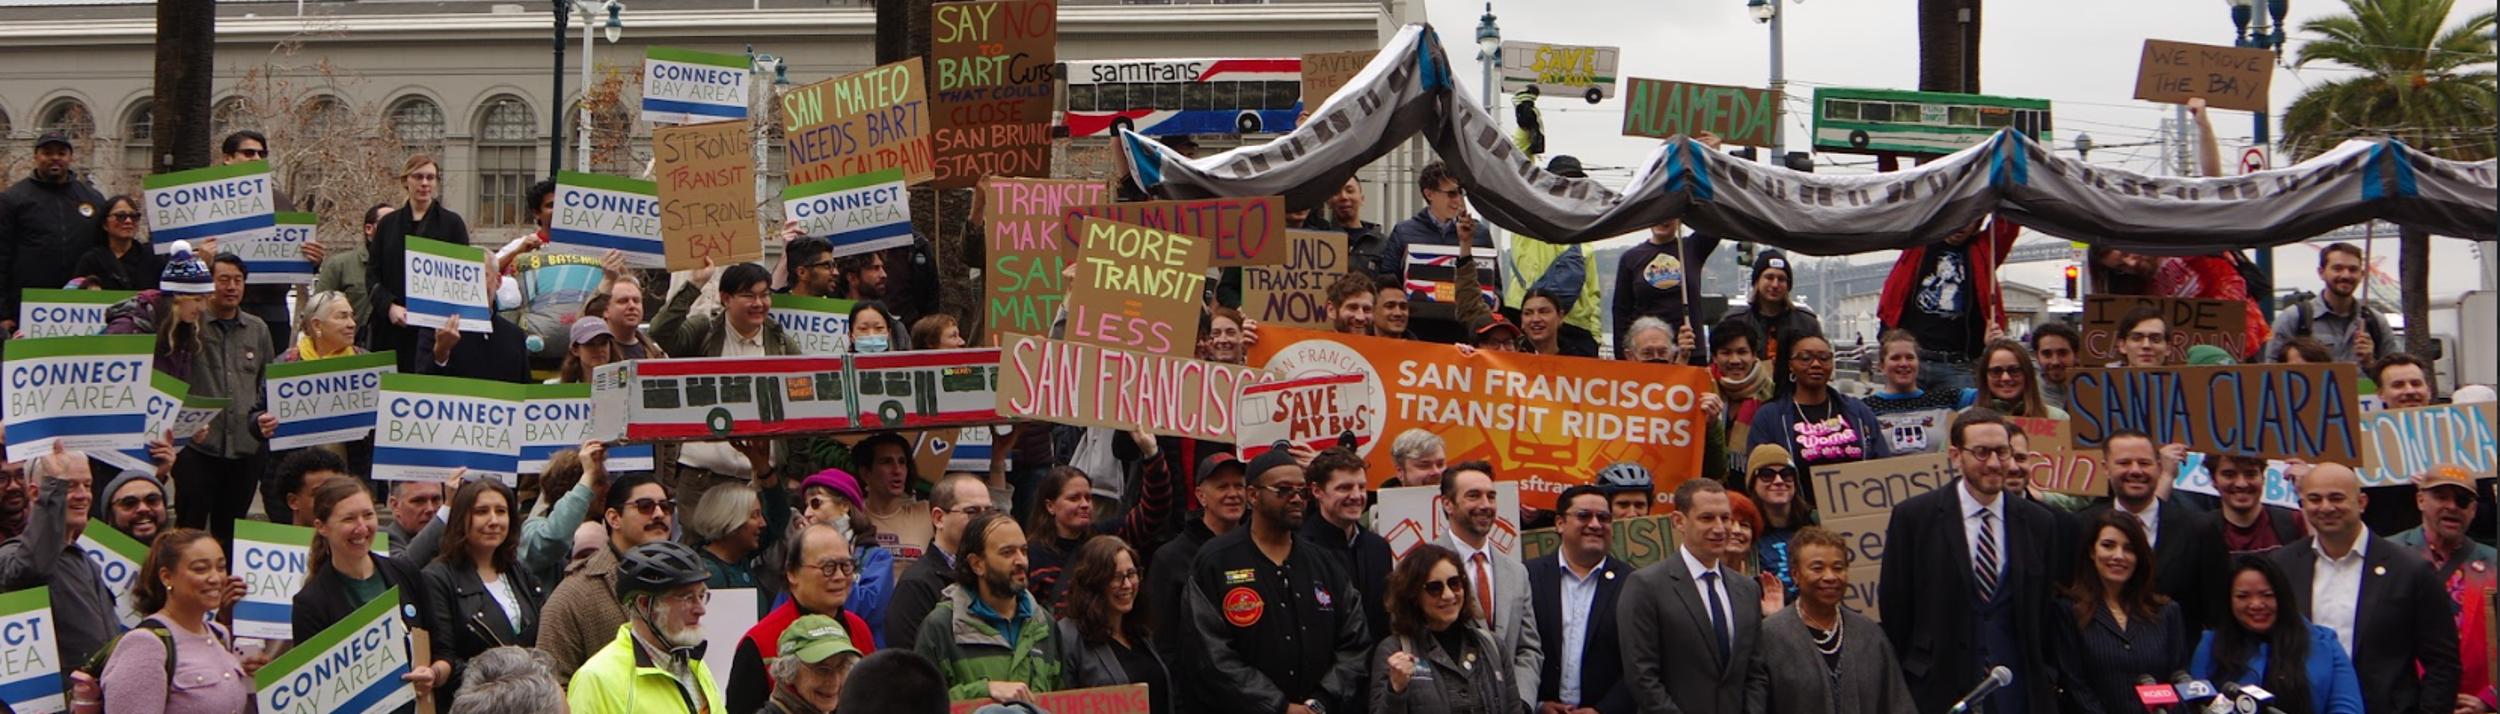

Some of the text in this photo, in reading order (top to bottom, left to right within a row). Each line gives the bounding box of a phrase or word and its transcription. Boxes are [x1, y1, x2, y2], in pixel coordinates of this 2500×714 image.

[937, 2, 1051, 43] SAY NO
[978, 43, 1004, 55] TO
[1530, 45, 1596, 73] SAVE
[2152, 48, 2262, 73] WE MOVE
[653, 64, 742, 86] CONNECT
[938, 55, 1010, 91] BART
[1092, 62, 1202, 82] samTrans
[2152, 73, 2260, 99] THE BAY
[652, 80, 740, 102] BAY AREA
[784, 65, 909, 132] SAN MATEO
[938, 84, 1051, 103] THAT COULD
[951, 100, 1025, 127] CLOSE
[1624, 79, 1774, 145] ALAMEDA
[663, 128, 749, 163] STRONG
[789, 100, 921, 166] NEEDS BART
[936, 127, 985, 151] SAN
[666, 165, 746, 192] TRANSIT
[934, 149, 1042, 181] STATION
[156, 179, 264, 208] CONNECT
[565, 190, 660, 217] CONNEC
[796, 186, 898, 217] CONNECT
[159, 196, 265, 227] BAY AREA
[562, 207, 604, 226] BAY
[665, 199, 755, 231] STRONG
[801, 204, 902, 235] BAY AREA
[688, 231, 736, 259] BAY
[1087, 223, 1192, 266] MORE
[1283, 239, 1336, 270] UND
[412, 257, 480, 284] CONNECT
[1086, 257, 1205, 303] TRANSIT
[412, 276, 482, 302] BAY AREA
[31, 307, 101, 323] CONN
[2090, 298, 2115, 324] I
[1076, 304, 1173, 353] LESS
[13, 361, 142, 389] CONNECT
[278, 371, 389, 399] CONNEC
[1009, 337, 1082, 417] SAN
[1398, 360, 1696, 414] SAN FRANCISCO
[12, 388, 53, 417] BAY
[60, 385, 136, 411] AREA
[279, 397, 326, 418] BAY
[391, 398, 516, 426] CONNECT
[525, 404, 590, 421] CONN
[1272, 385, 1338, 422] SAVE
[2071, 369, 2357, 457] SANTA CLARA
[525, 423, 569, 441] BAY
[1290, 415, 1325, 441] MY
[1330, 404, 1367, 436] BUS
[1395, 392, 1550, 434] TRANSIT
[1561, 405, 1692, 447] RIDERS
[388, 420, 512, 449] BAY AREA
[245, 572, 293, 597] BAY
[271, 617, 392, 711] CONNECT
[332, 645, 396, 703] AREA
